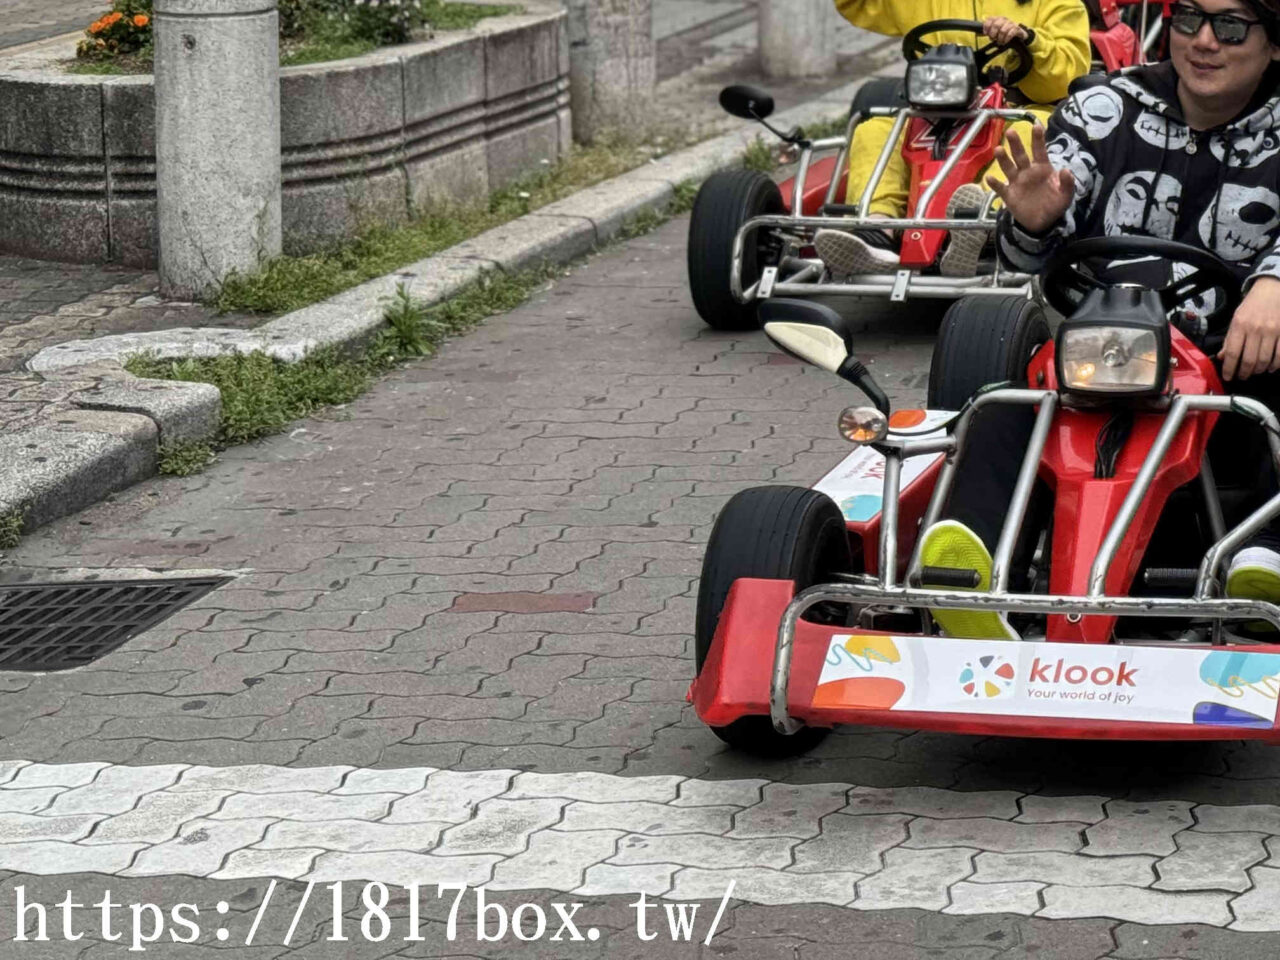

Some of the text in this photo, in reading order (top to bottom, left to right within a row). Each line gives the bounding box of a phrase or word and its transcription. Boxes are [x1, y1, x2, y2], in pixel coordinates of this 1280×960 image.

[1029, 657, 1139, 687] klook
[1027, 688, 1135, 705] Your world of joy
